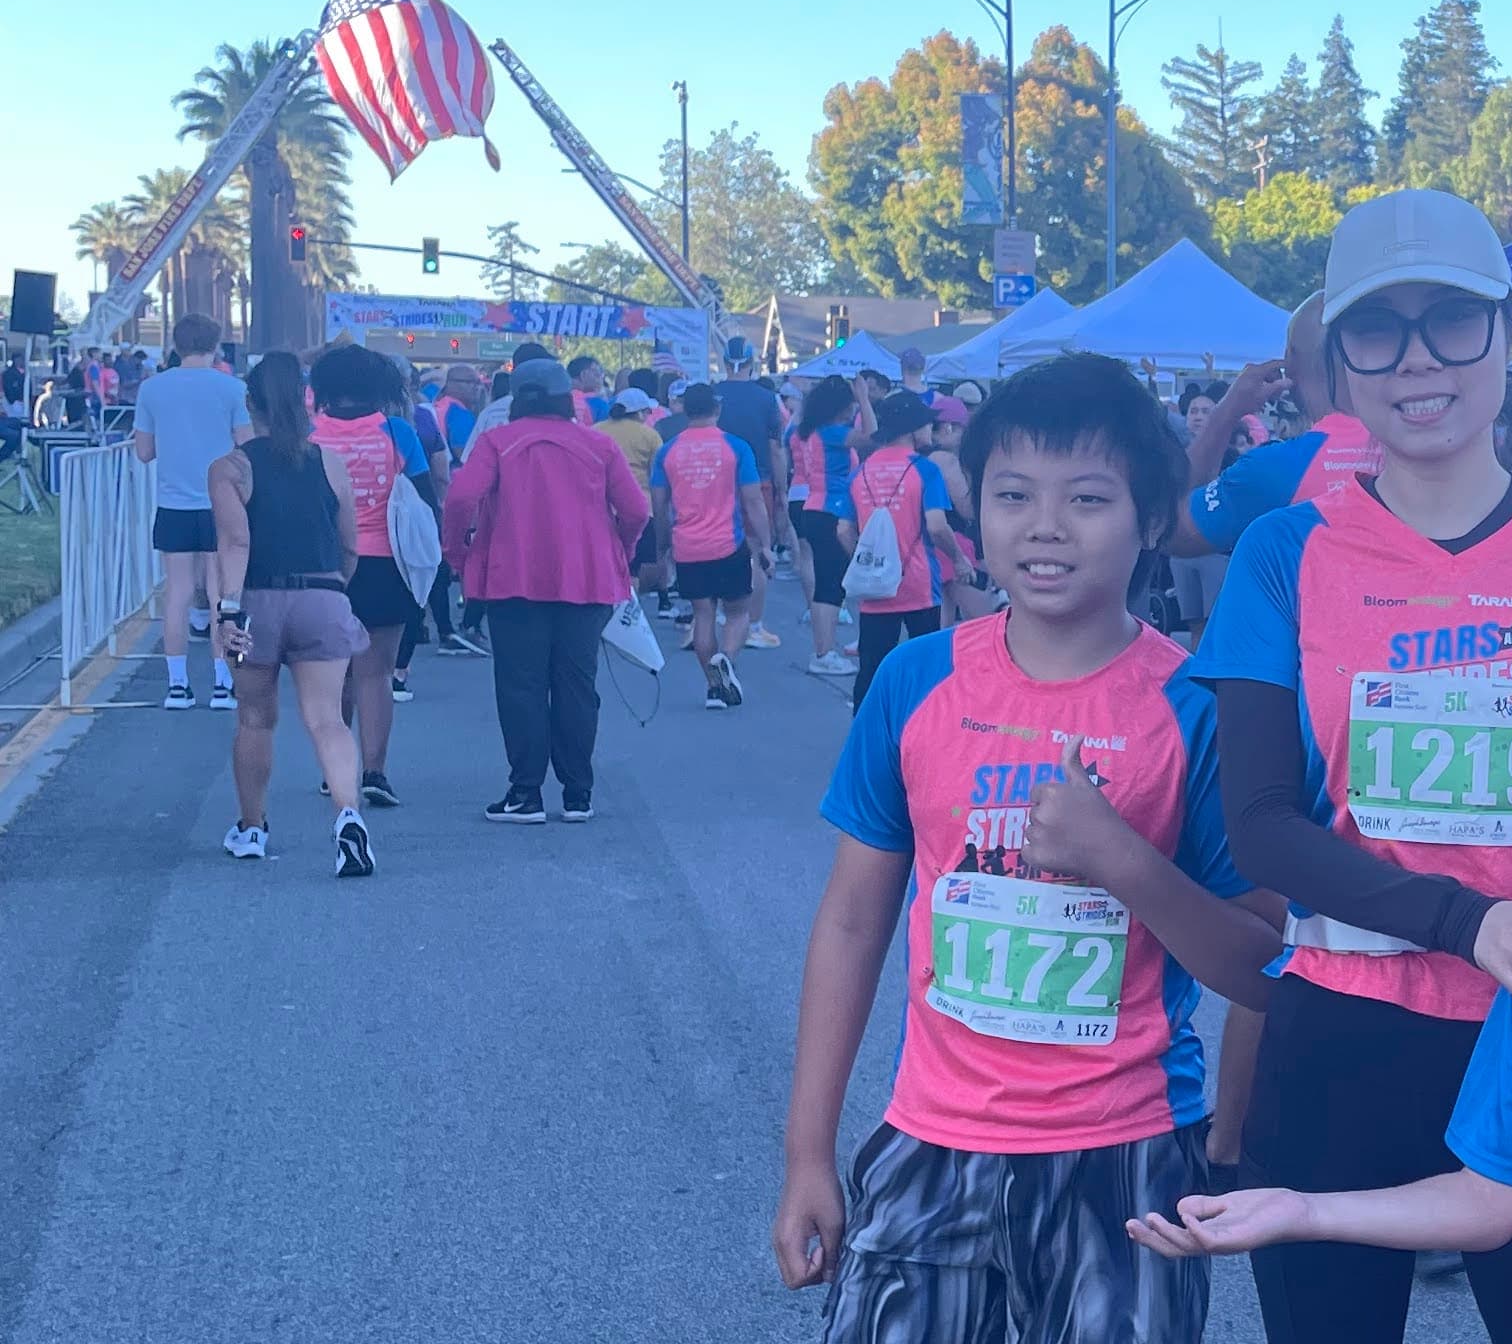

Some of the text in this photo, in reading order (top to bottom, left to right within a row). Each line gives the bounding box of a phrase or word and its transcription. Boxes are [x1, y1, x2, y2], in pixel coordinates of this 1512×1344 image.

[998, 278, 1015, 303] P
[524, 304, 617, 337] START
[1388, 620, 1500, 671] STARS
[1444, 691, 1468, 714] 5K
[1051, 729, 1110, 749] TAANA
[1016, 895, 1039, 916] 5K
[944, 921, 1114, 1008] 1172
[936, 996, 965, 1019] DRINK
[1076, 1023, 1109, 1038] 1172
